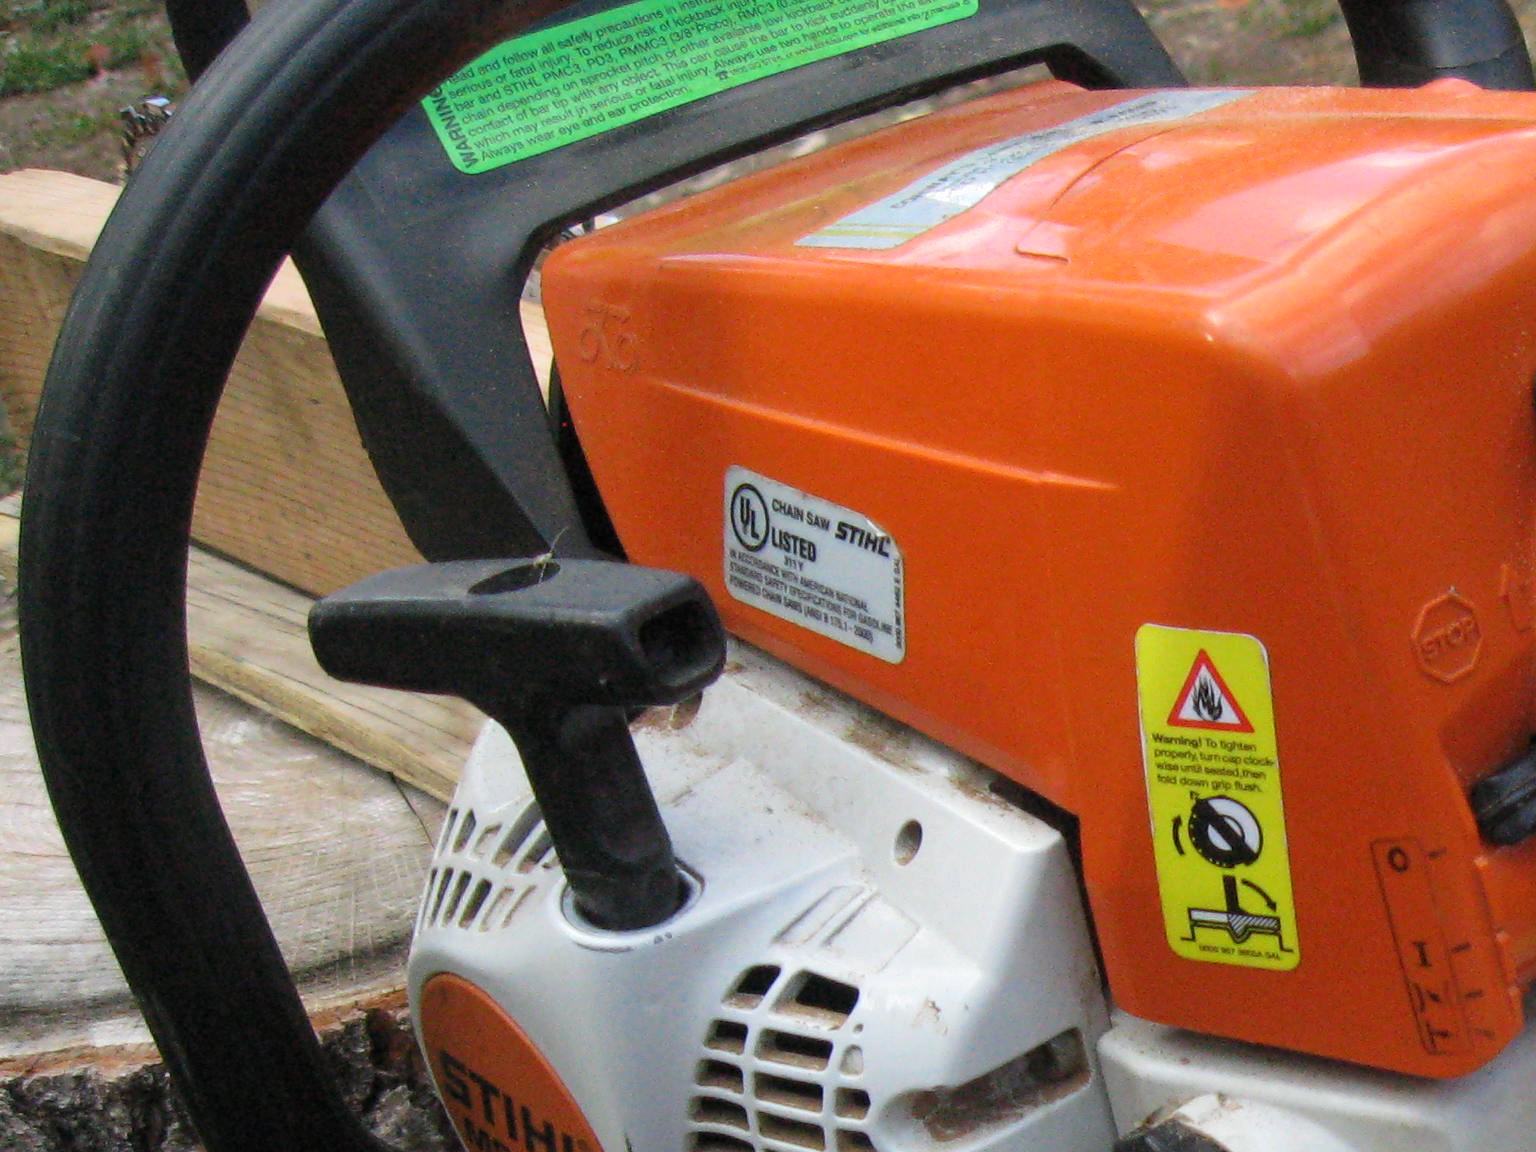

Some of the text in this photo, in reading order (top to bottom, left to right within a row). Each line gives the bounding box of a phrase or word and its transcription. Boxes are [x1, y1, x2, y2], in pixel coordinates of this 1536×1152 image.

[448, 79, 494, 99] serious
[495, 73, 508, 84] or
[509, 64, 537, 79] fatal
[576, 47, 591, 58] To
[593, 34, 634, 53] reduce
[636, 26, 657, 39] risk
[659, 20, 671, 32] of
[673, 5, 722, 27] kickback
[469, 115, 513, 137] contact
[515, 110, 527, 121] of
[530, 105, 551, 116] bar
[552, 98, 569, 110] tip
[571, 89, 596, 104] with
[598, 82, 619, 95] any
[662, 60, 689, 72] This
[690, 53, 711, 65] can
[714, 42, 749, 57] cause
[749, 33, 769, 46] the
[770, 26, 789, 40] bar
[791, 22, 804, 32] to
[805, 15, 829, 27] kick
[831, 1, 879, 20] suddenly
[477, 60, 500, 75] and
[502, 48, 539, 65] follow
[541, 43, 555, 55] all
[558, 30, 593, 49] safety
[595, 10, 664, 39] precautions
[665, 6, 677, 15] in
[454, 99, 475, 112] bar
[479, 90, 502, 104] and
[503, 79, 541, 96] STIHL
[618, 36, 668, 58] PMMC3
[462, 108, 494, 124] chain
[497, 87, 561, 115] depending
[581, 64, 632, 87] sprocket
[634, 53, 662, 70] pitch
[665, 49, 677, 59] or
[680, 39, 709, 54] other
[712, 21, 761, 45] available
[762, 15, 783, 28] low
[474, 131, 511, 149] which
[512, 122, 539, 137] may
[541, 110, 575, 127] result
[591, 92, 633, 110] serious
[635, 87, 647, 97] or
[649, 78, 676, 90] fatal
[714, 52, 755, 70] Always
[756, 44, 778, 57] use
[779, 37, 800, 50] two
[802, 26, 838, 41] hands
[839, 22, 852, 32] to
[854, 8, 896, 26] operate
[482, 140, 524, 162] Always
[527, 130, 555, 145] wear
[558, 122, 580, 136] eye
[582, 112, 605, 127] and
[607, 107, 627, 118] ear
[740, 496, 760, 540] UL
[771, 526, 817, 563] LISTED
[772, 499, 891, 558] CHAIN SAW STIHL
[1152, 732, 1257, 753] Warning! To tighten
[1154, 748, 1242, 765] properly, turn cap
[1157, 762, 1203, 774] wise until
[1157, 773, 1178, 785] fold
[1179, 777, 1209, 788] down
[1211, 781, 1232, 791] grip
